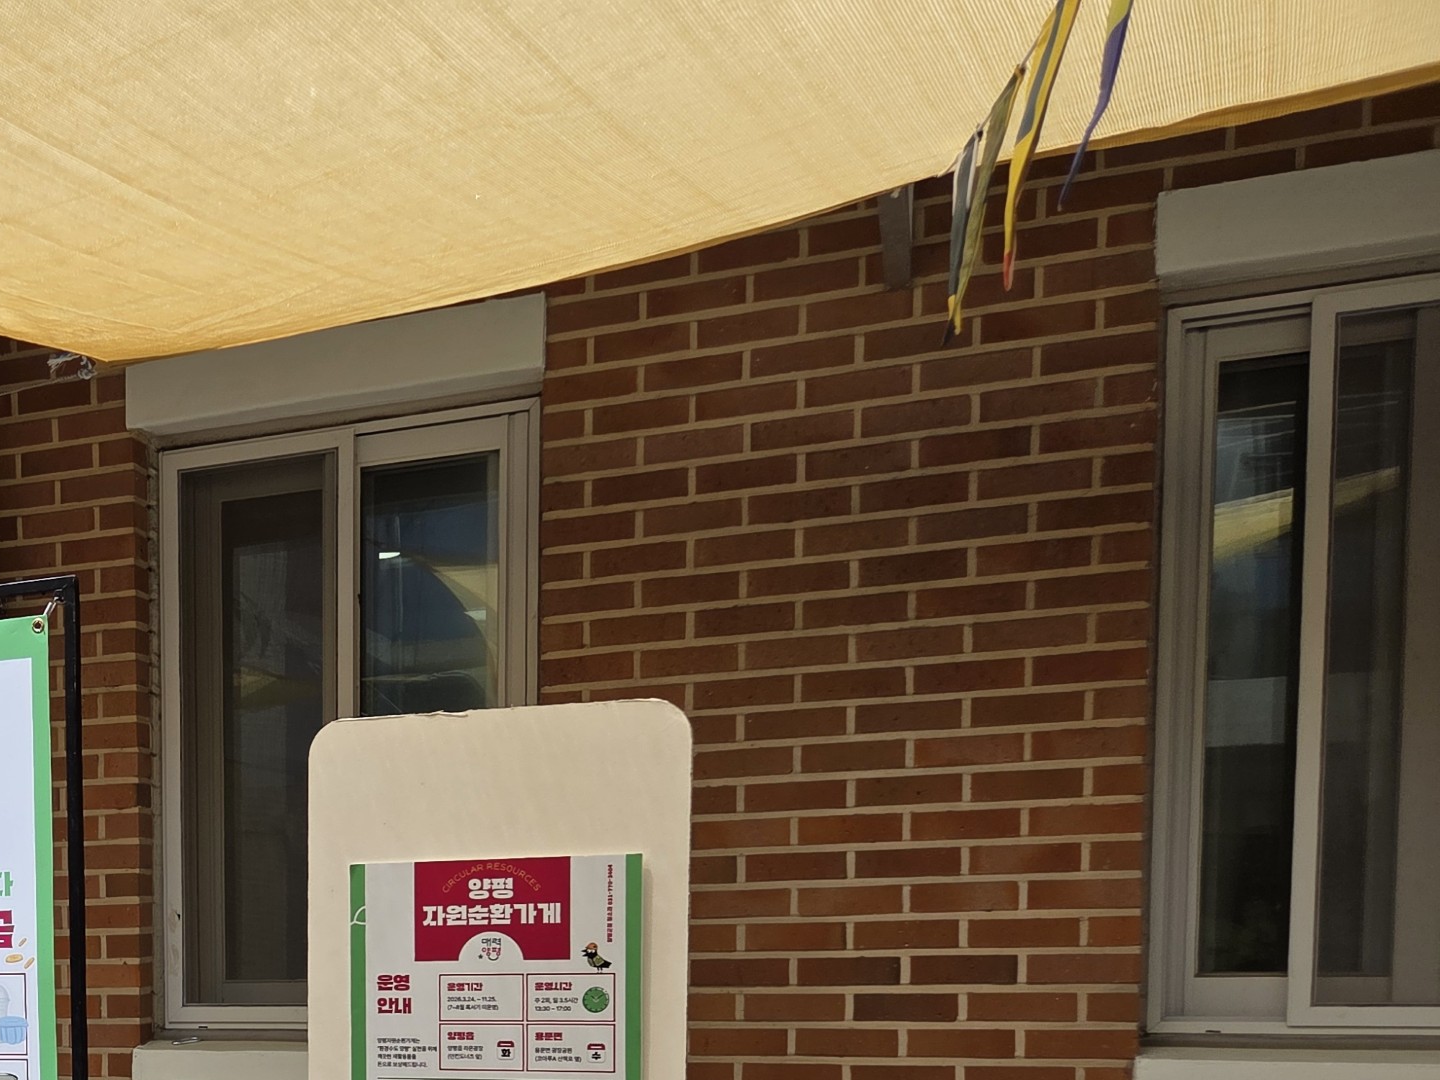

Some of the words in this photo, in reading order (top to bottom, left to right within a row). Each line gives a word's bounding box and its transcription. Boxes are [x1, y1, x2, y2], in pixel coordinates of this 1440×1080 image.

[442, 863, 483, 893] CIRCULAR
[486, 862, 542, 892] RESOURCES
[468, 877, 514, 900] 양평
[422, 902, 561, 926] 자원순환가게
[481, 938, 501, 946] 매력
[481, 947, 501, 957] 양평
[377, 974, 410, 991] 운영
[447, 982, 483, 992] 운영기간
[535, 982, 572, 991] 운영시간
[377, 997, 412, 1014] 안내
[447, 1031, 474, 1040] 양평읍
[501, 1048, 511, 1057] 화
[591, 1051, 601, 1060] 수
